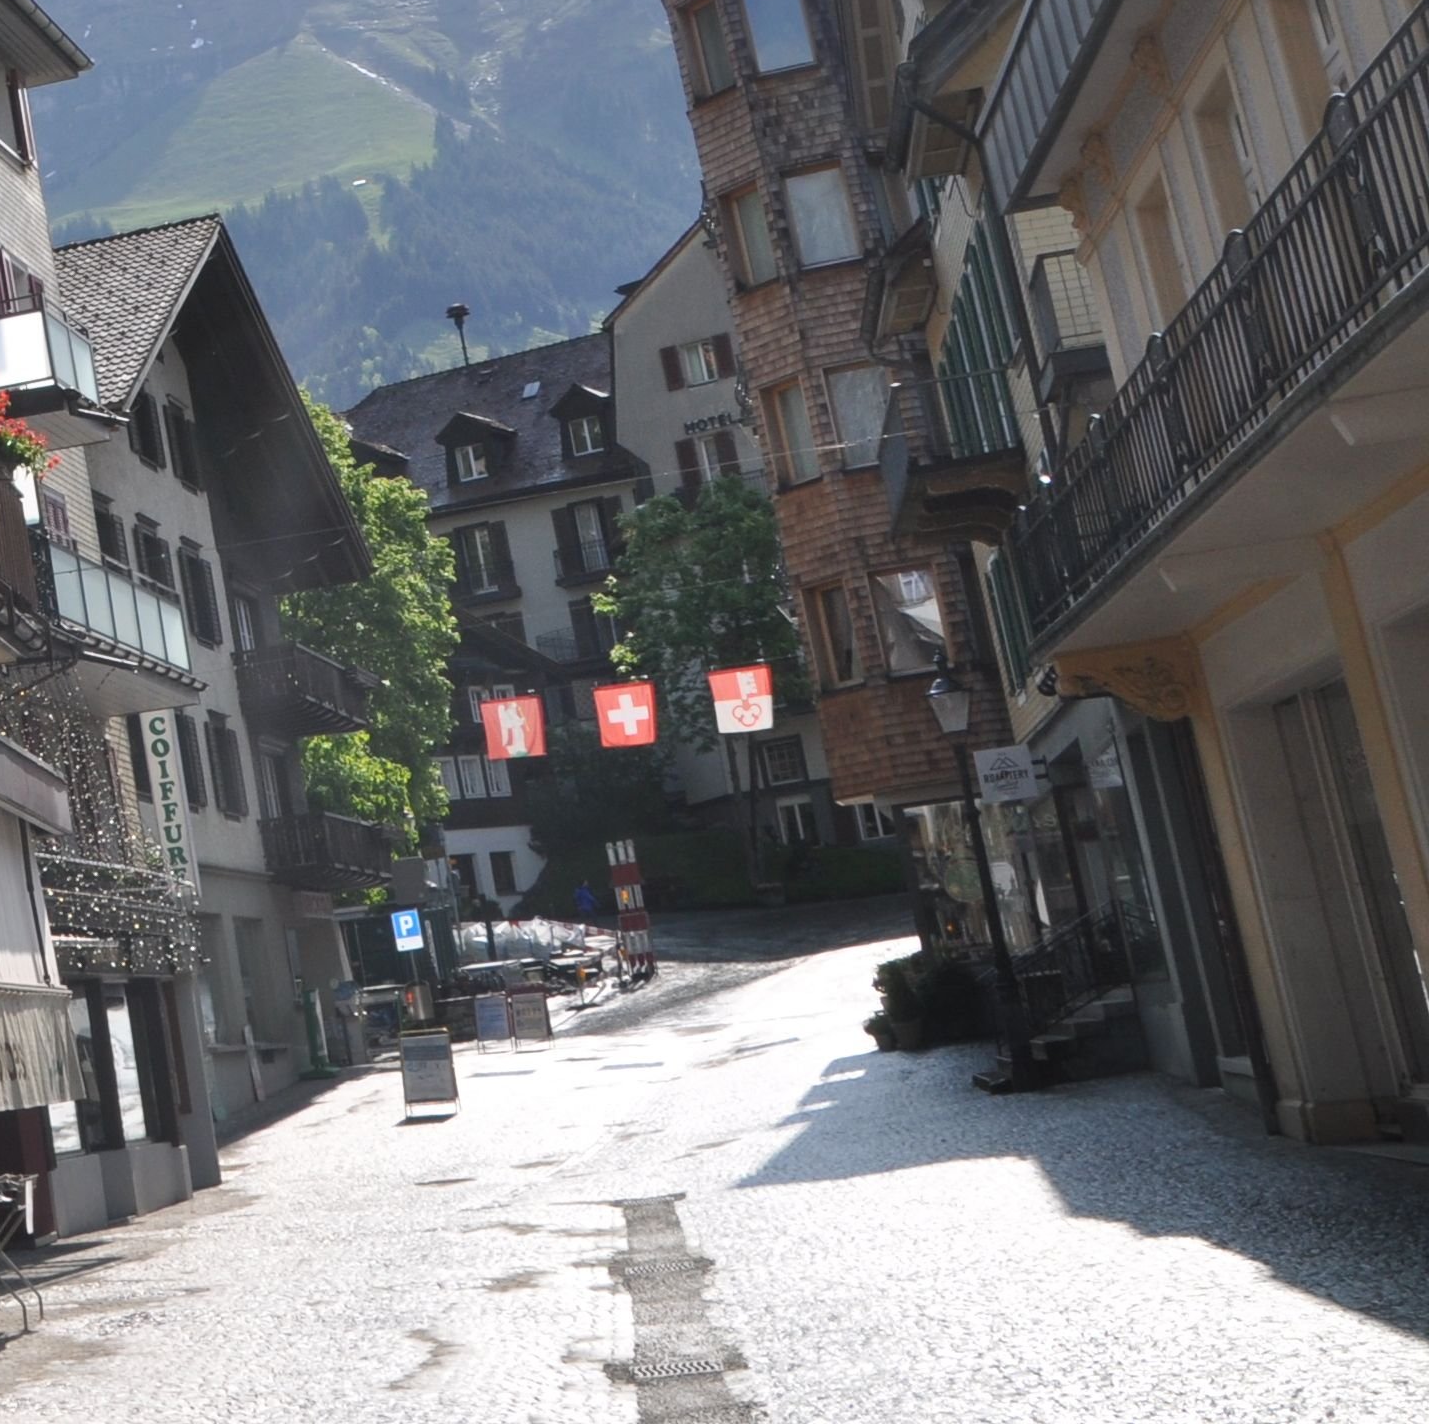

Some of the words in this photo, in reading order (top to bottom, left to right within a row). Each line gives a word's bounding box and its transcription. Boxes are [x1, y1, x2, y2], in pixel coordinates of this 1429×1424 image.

[683, 412, 738, 436] HOTEL
[148, 716, 189, 883] COIFFURE
[399, 915, 414, 937] P
